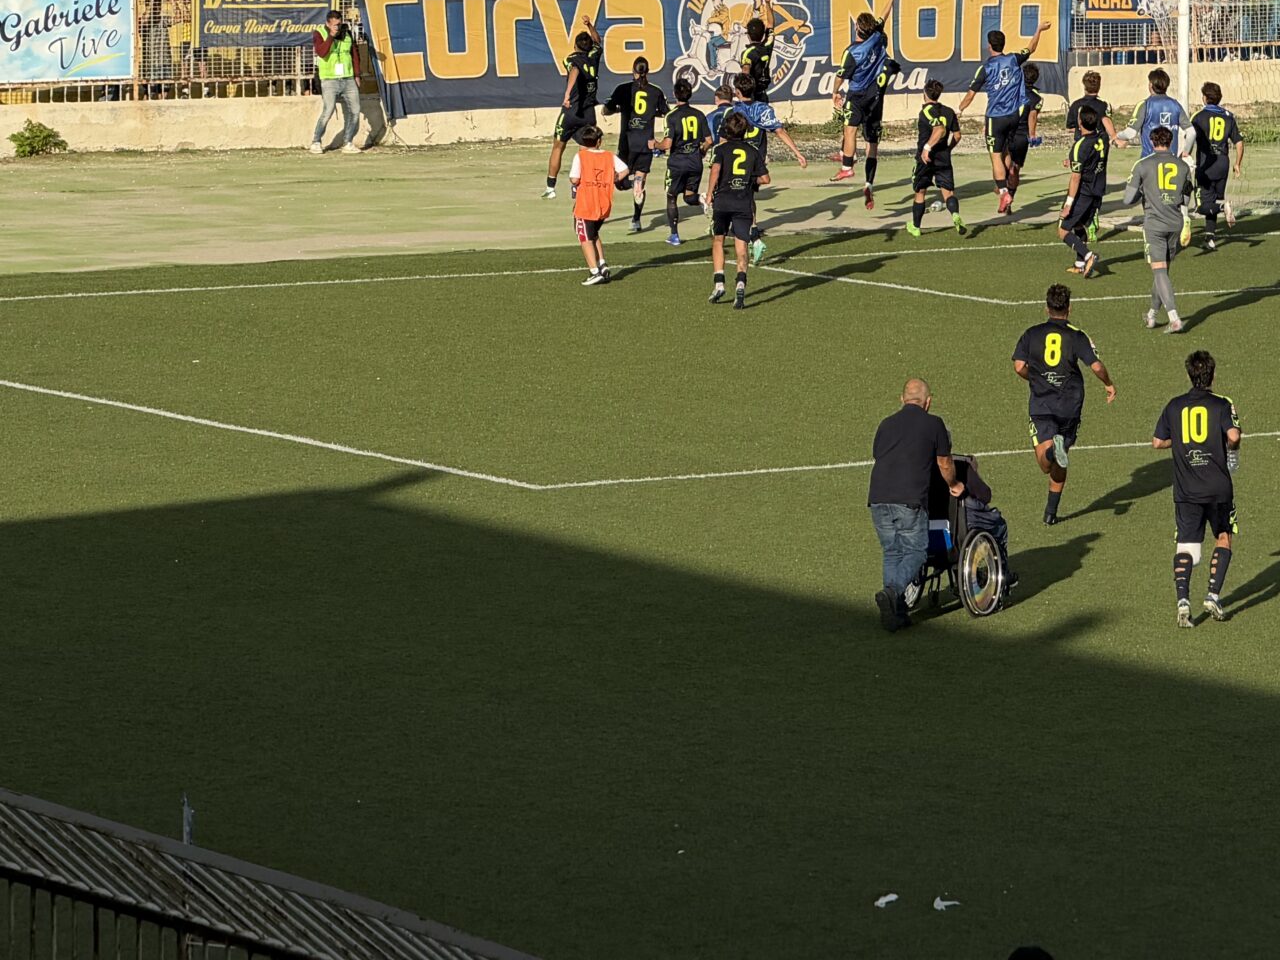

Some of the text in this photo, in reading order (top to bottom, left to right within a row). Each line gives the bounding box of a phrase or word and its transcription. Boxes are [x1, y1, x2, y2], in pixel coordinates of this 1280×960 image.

[204, 20, 241, 34] Curva
[243, 19, 279, 33] Nord
[48, 26, 122, 70] Vive
[773, 59, 791, 85] 2011
[791, 56, 928, 96] Fara
[634, 91, 648, 115] 6
[682, 115, 698, 141] 19
[1208, 116, 1225, 141] 18
[732, 149, 747, 175] 2
[1157, 162, 1178, 191] 12
[1044, 333, 1062, 367] 8
[1181, 406, 1209, 444] 10
